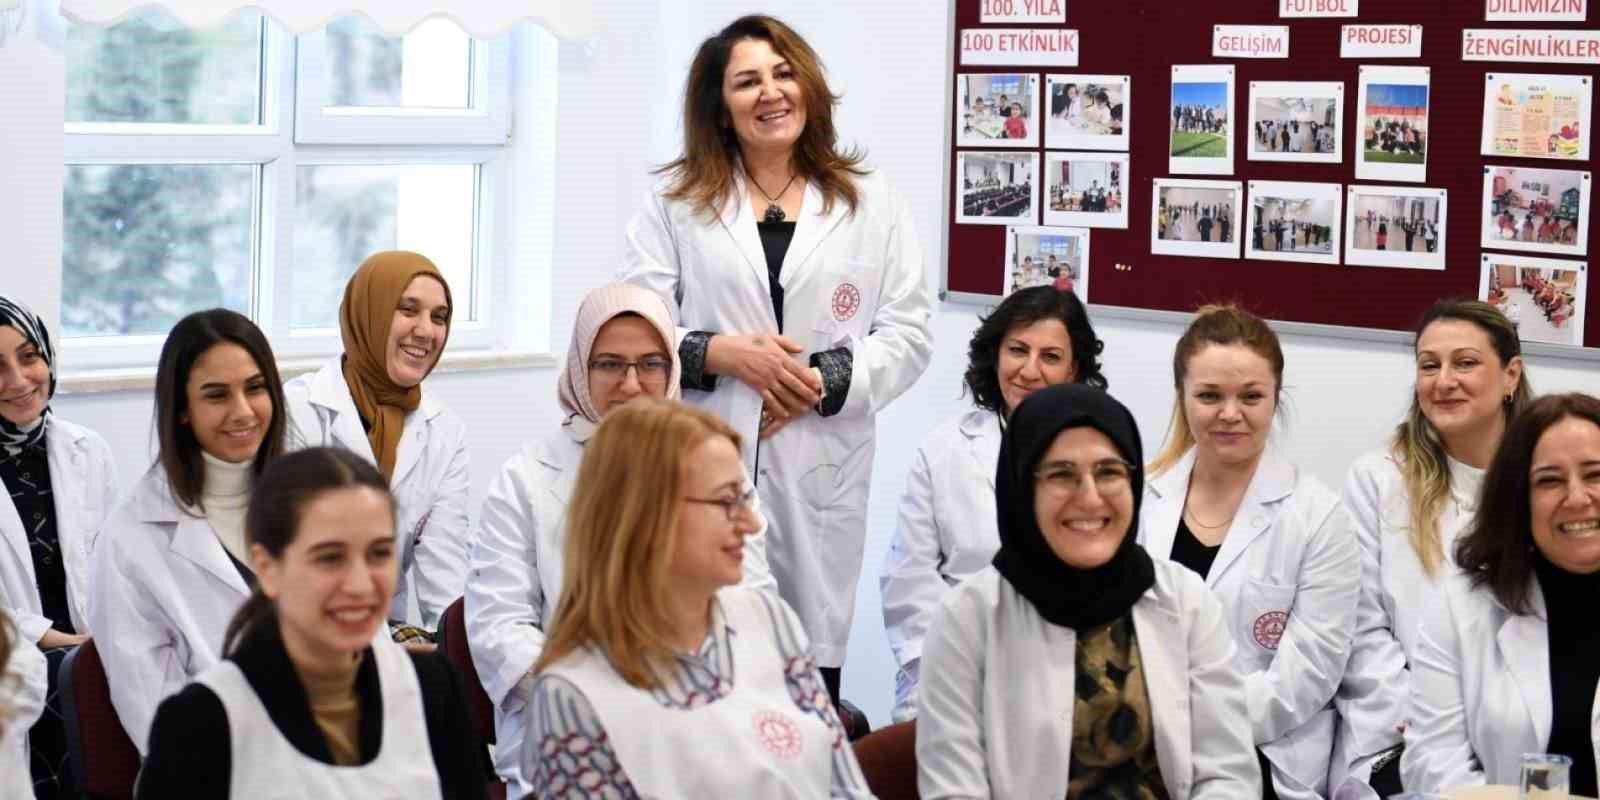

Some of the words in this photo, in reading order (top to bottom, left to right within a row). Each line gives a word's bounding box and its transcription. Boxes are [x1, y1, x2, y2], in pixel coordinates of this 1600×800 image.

[983, 0, 1018, 16] 100.
[1286, 0, 1347, 12] FUTBOL
[963, 33, 993, 52] 100
[999, 30, 1074, 52] ETKİNLİK
